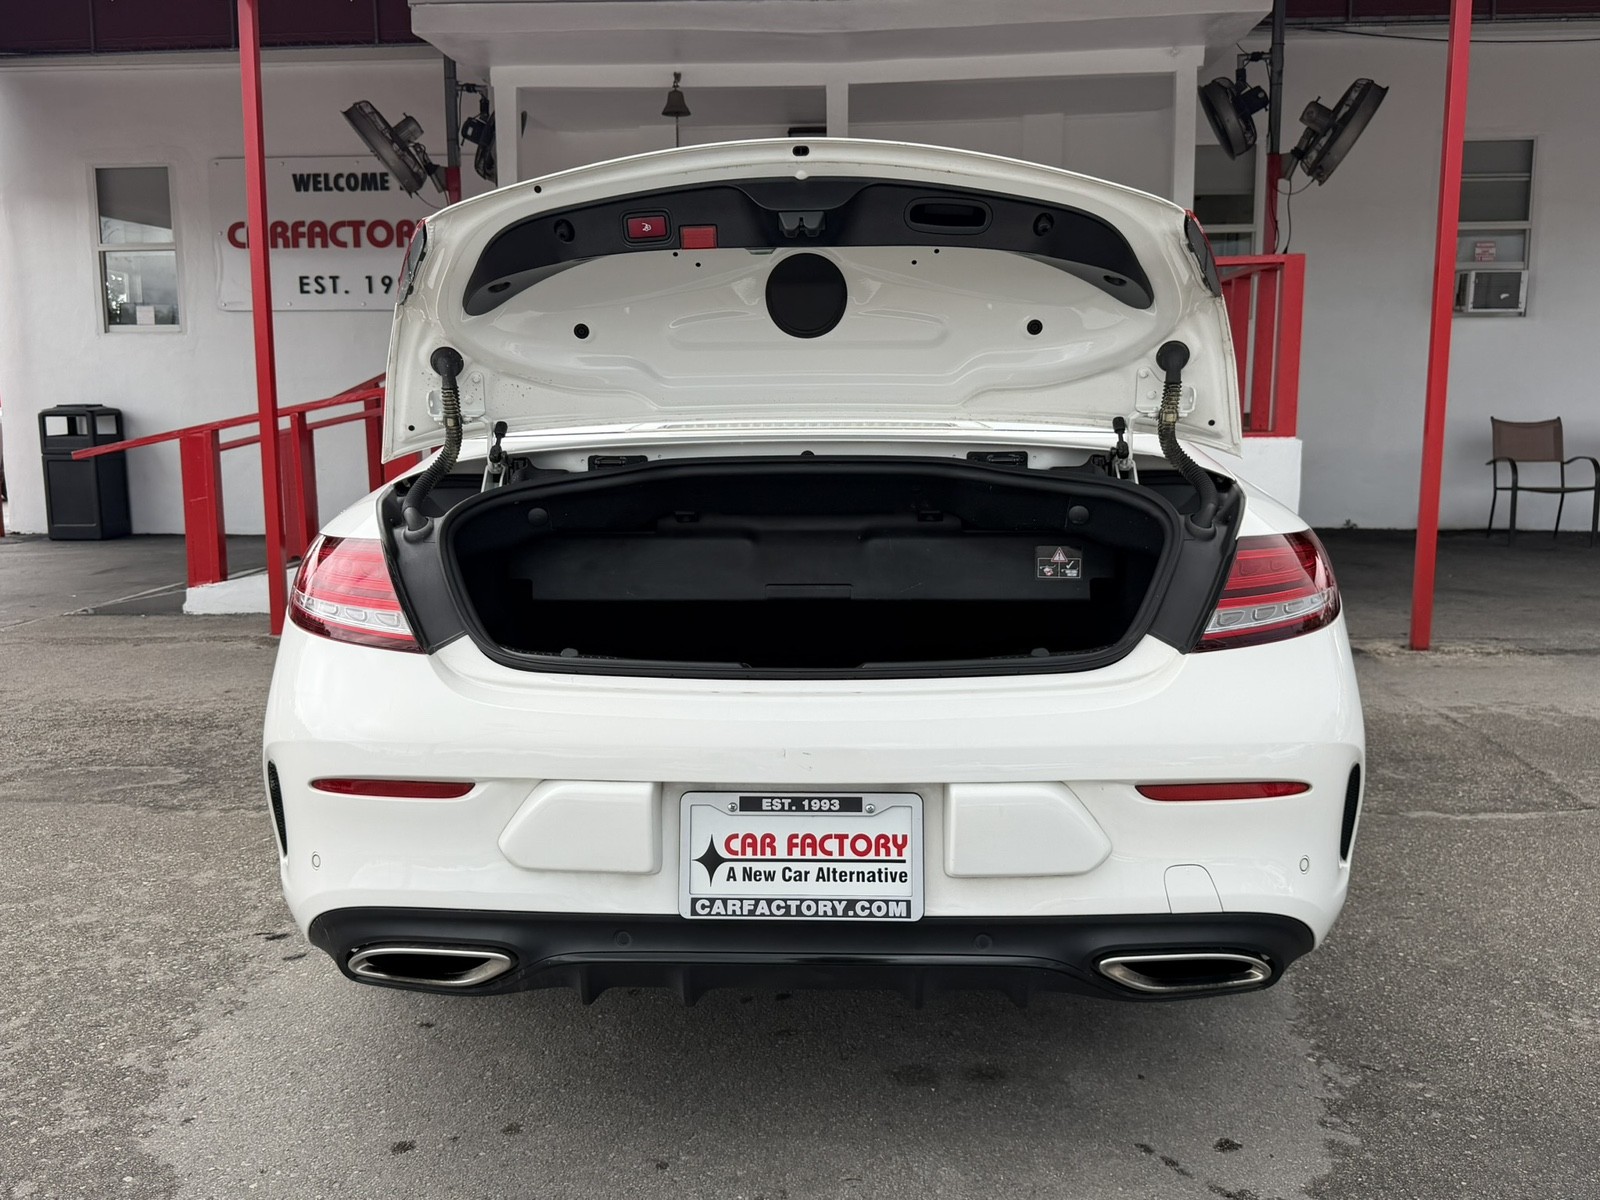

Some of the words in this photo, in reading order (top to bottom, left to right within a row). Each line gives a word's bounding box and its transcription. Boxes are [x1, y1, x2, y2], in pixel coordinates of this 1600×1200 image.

[292, 172, 390, 192] WELCOME
[227, 219, 422, 249] CRFACTOR
[299, 275, 350, 294] EST.
[365, 275, 400, 294] 19
[762, 799, 796, 810] EST.
[802, 800, 840, 810] 1993
[724, 833, 776, 856] CAR
[787, 833, 908, 857] FACTORY
[726, 867, 737, 881] A
[742, 867, 776, 882] New
[782, 867, 810, 882] Car
[816, 868, 908, 883] Alternative
[695, 900, 907, 917] CARFACTORY.COM
